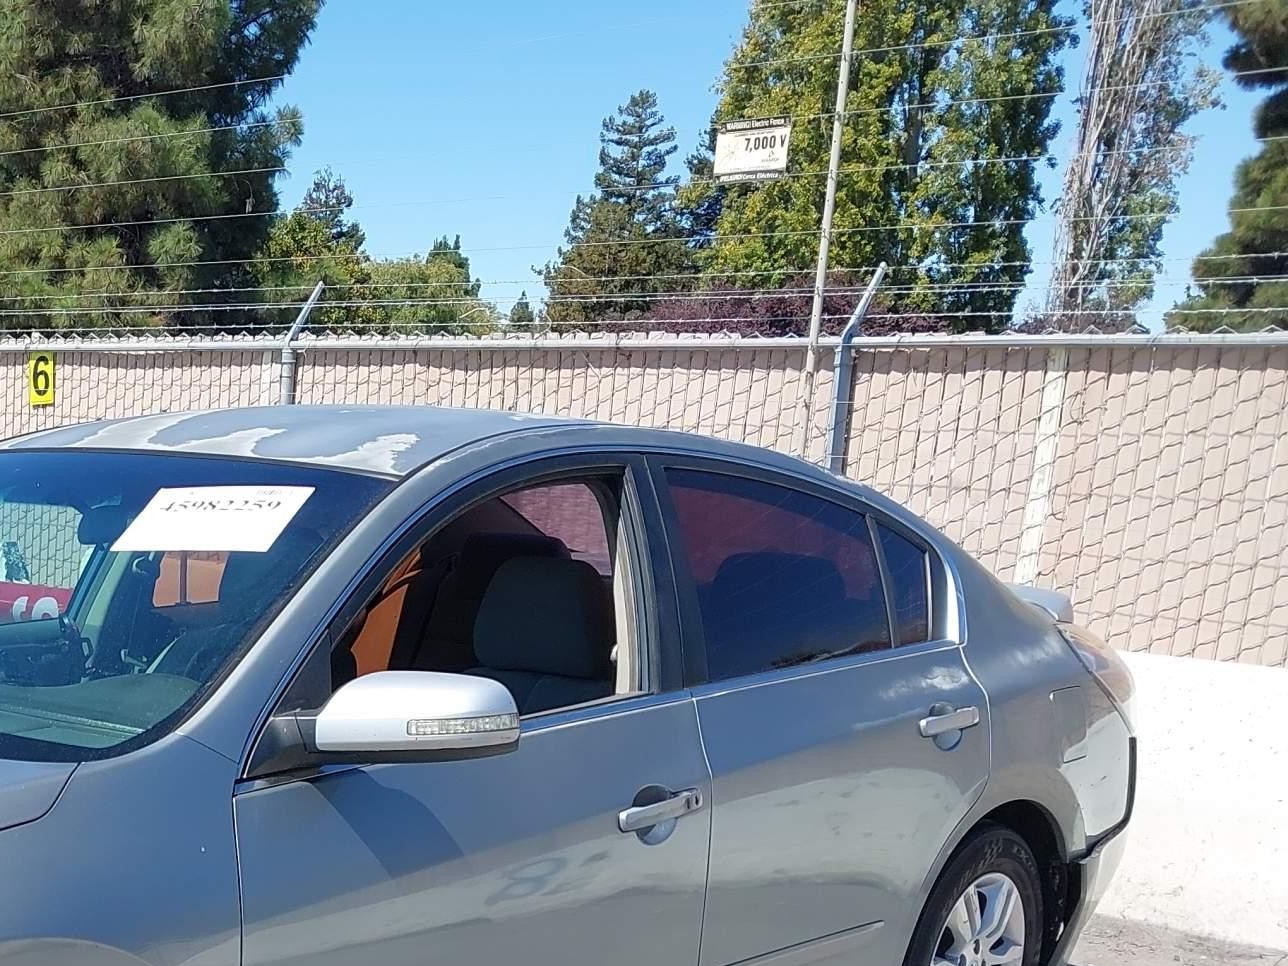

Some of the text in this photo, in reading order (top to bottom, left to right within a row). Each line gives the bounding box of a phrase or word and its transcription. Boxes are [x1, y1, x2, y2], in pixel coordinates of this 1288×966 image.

[744, 135, 776, 152] 7,000
[780, 133, 787, 148] V
[32, 355, 50, 397] 6
[161, 500, 282, 512] 45982259
